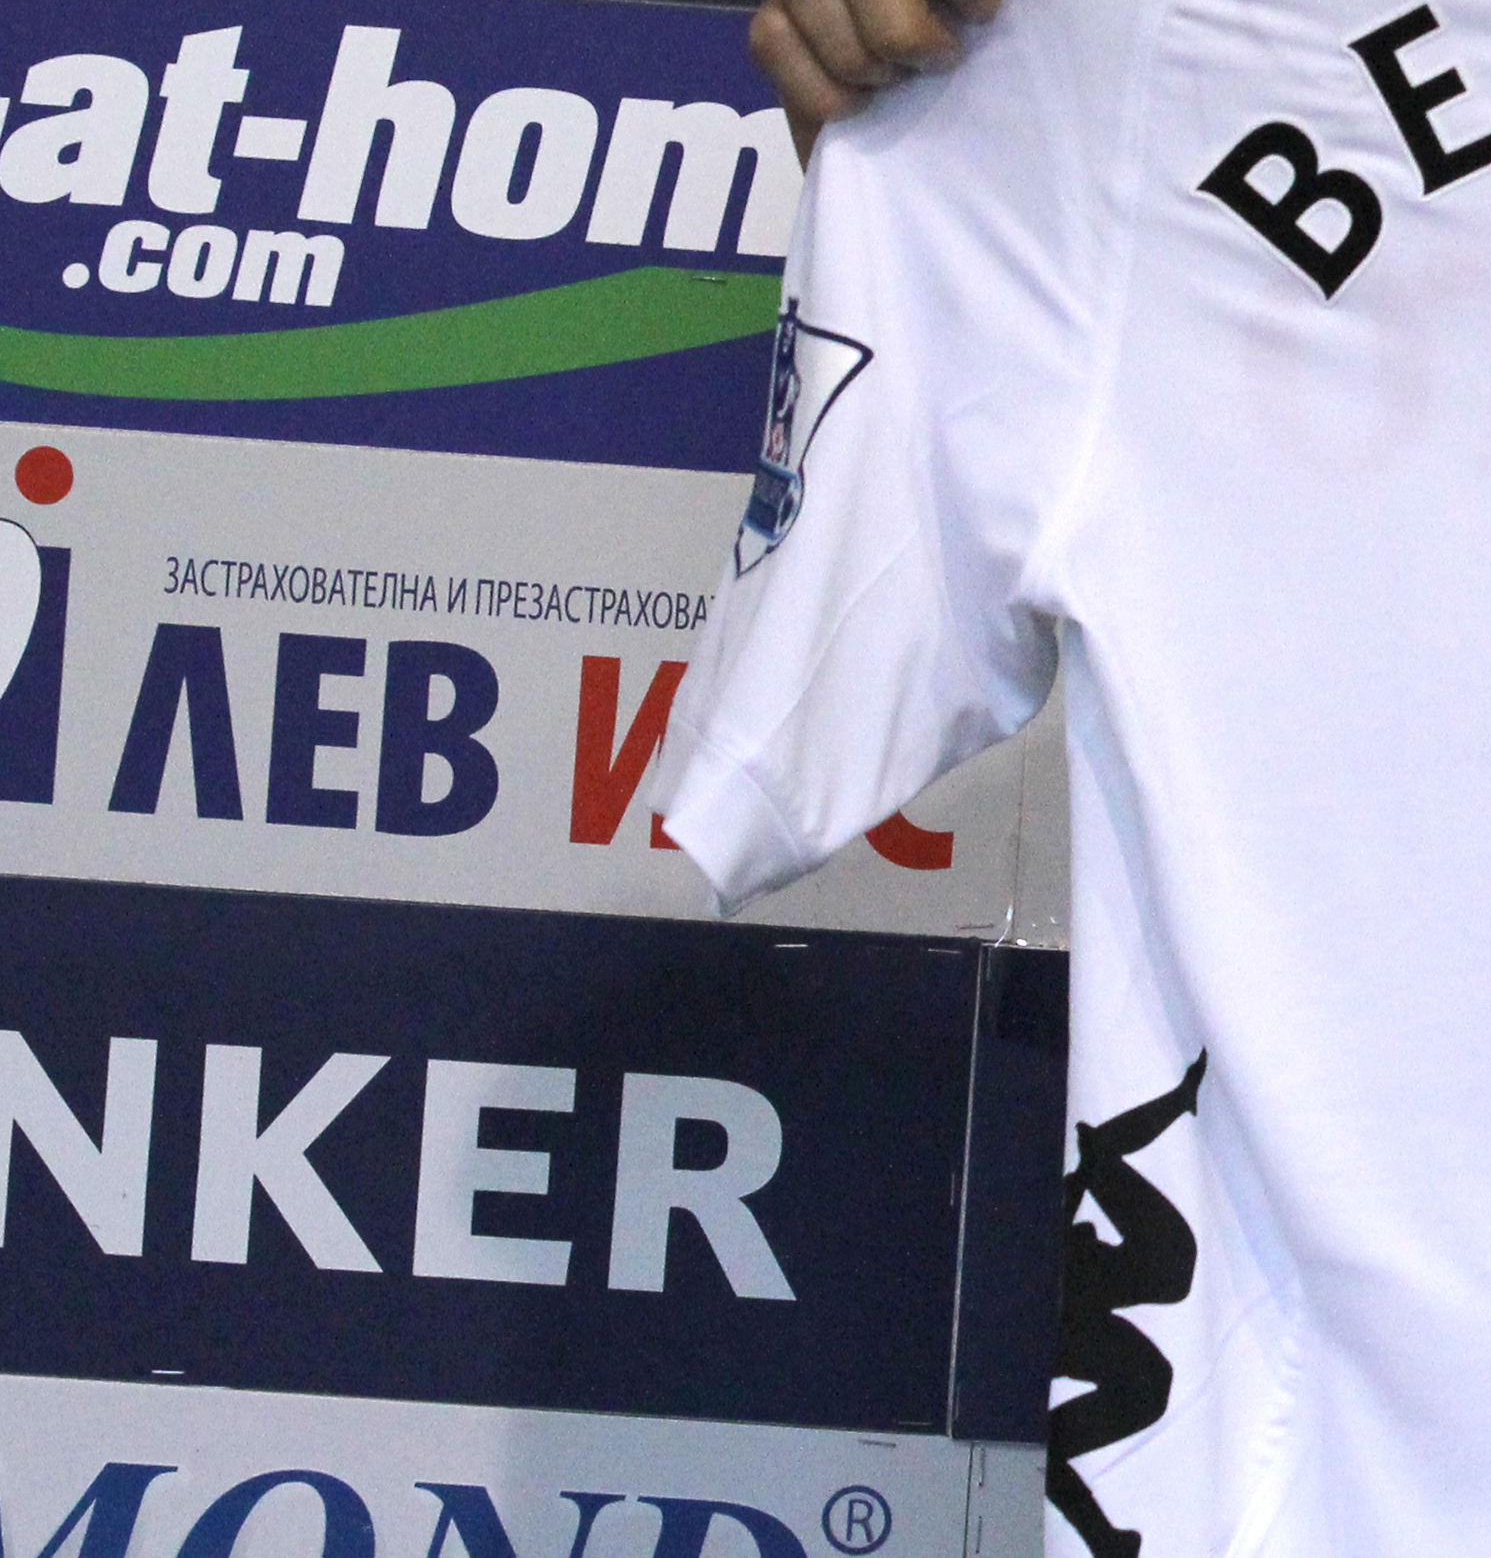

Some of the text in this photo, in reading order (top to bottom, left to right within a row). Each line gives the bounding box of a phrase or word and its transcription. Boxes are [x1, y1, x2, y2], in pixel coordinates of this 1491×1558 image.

[0, 25, 806, 258] at-hom
[62, 220, 345, 308] .com
[163, 556, 715, 632] ЗАСТРАХОВАТЕЛНА И ПРЕЗАСТРАХОВА
[108, 622, 500, 837] ЛЕВ
